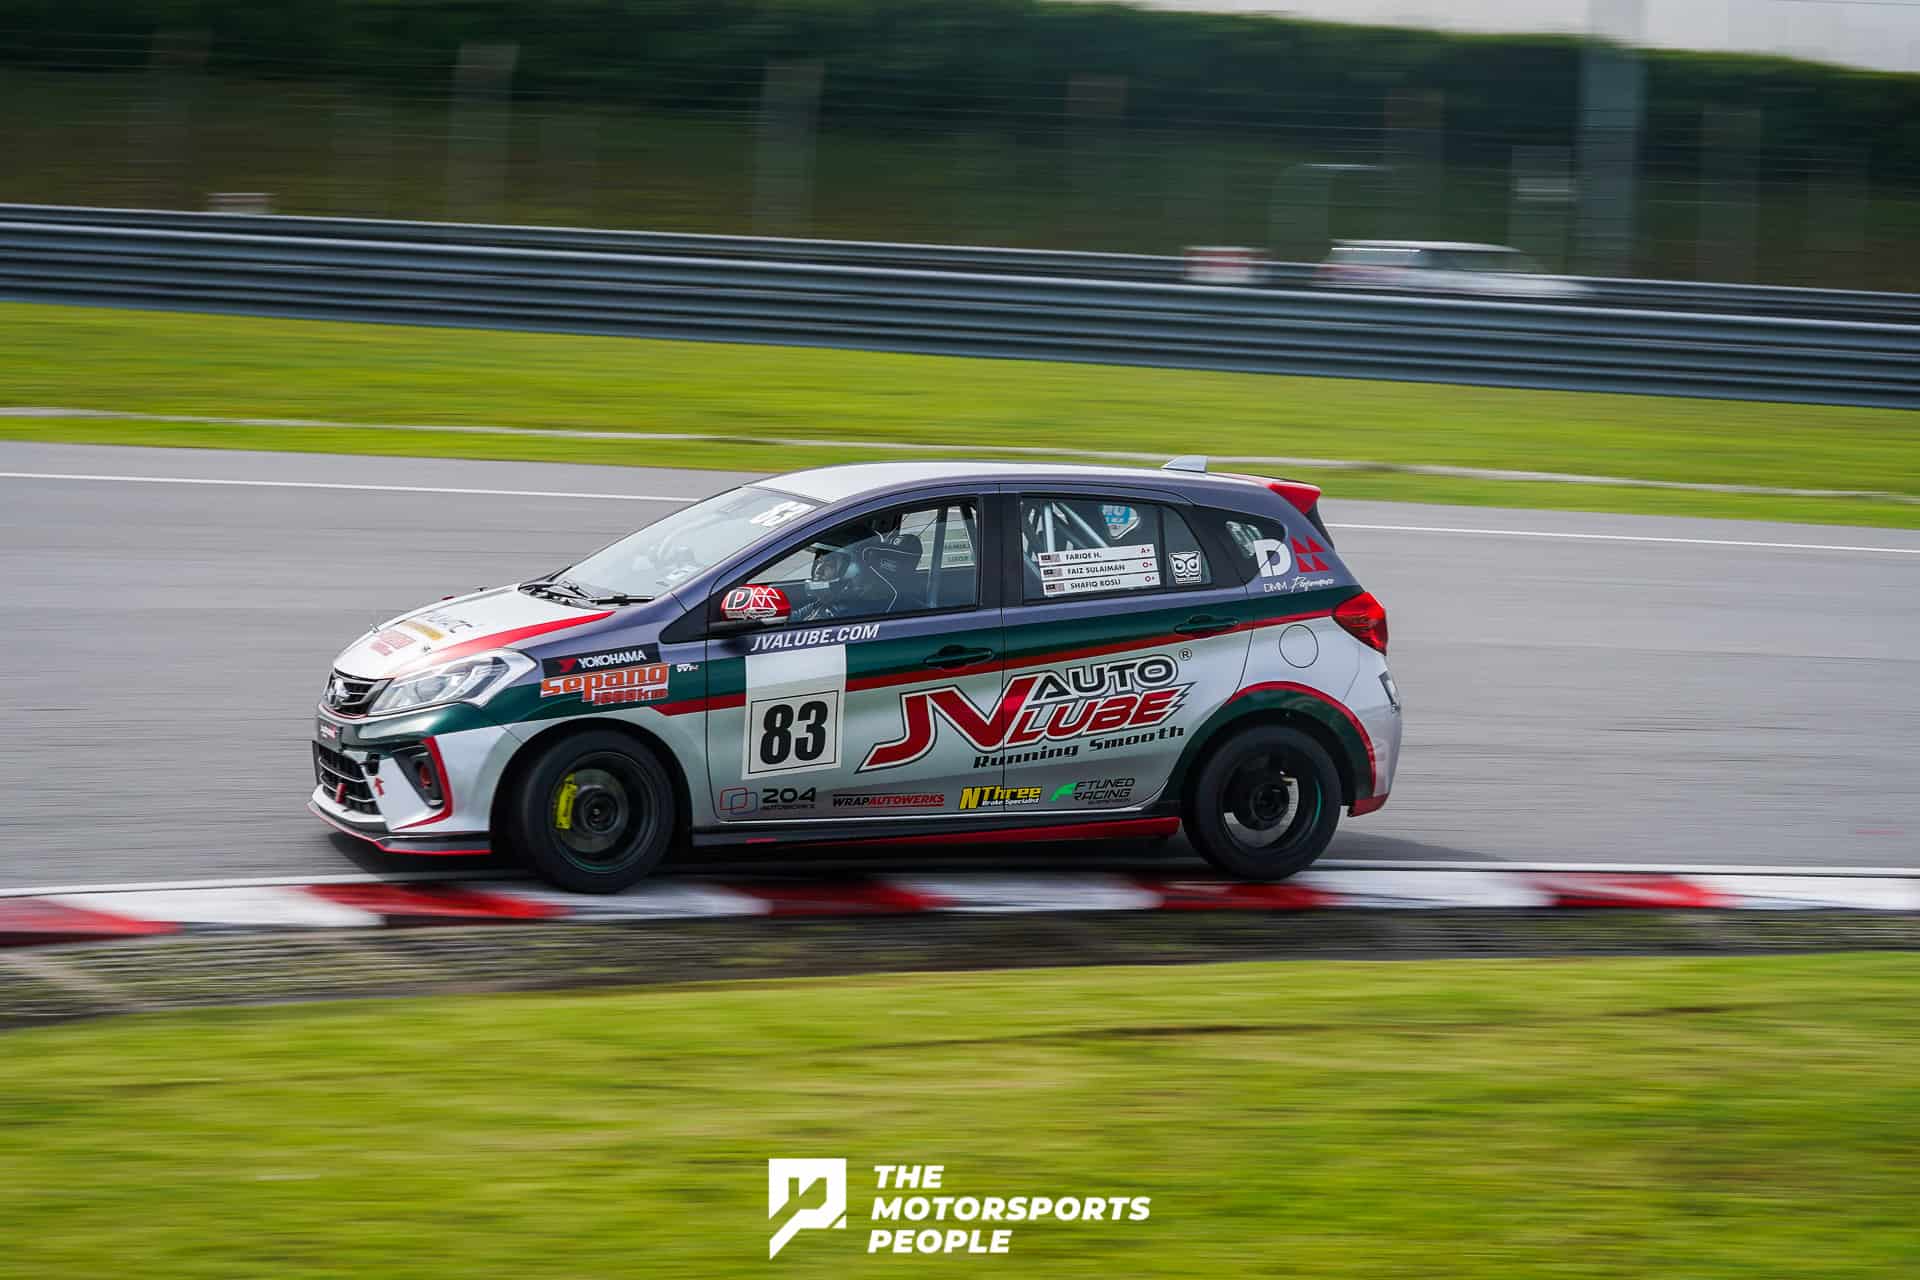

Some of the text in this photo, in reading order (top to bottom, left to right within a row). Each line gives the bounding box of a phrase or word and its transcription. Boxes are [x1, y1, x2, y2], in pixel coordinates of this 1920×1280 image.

[1067, 564, 1125, 575] FAIZ SULAIMAN
[1070, 579, 1121, 590] SHAFIQ ROSLI
[750, 623, 880, 652] JVALUBE.COM
[578, 650, 647, 669] YOKOHAMA
[1032, 656, 1177, 701] AUTO
[856, 674, 1041, 773] JV
[1007, 684, 1194, 746] LUBE
[760, 700, 828, 765] 83
[973, 726, 1185, 769] Running Smooth
[762, 787, 817, 804] 204
[1072, 788, 1132, 801] RACING
